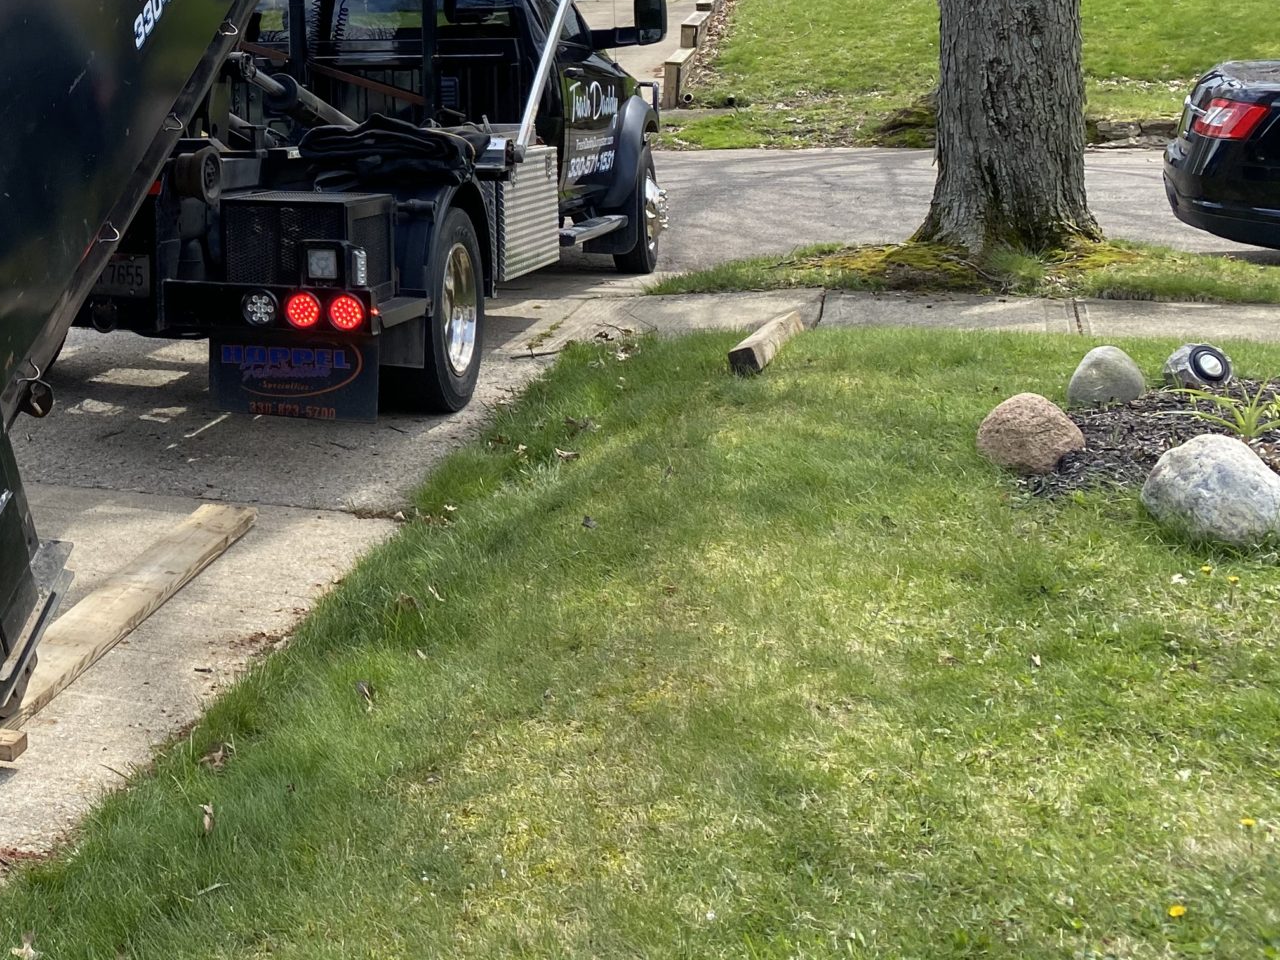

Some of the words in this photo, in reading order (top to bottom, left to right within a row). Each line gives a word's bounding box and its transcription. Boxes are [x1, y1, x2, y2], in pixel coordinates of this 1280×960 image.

[569, 81, 591, 123] Trash
[590, 81, 618, 130] Daddy
[108, 264, 144, 287] 7655
[221, 344, 351, 369] HOPPEL
